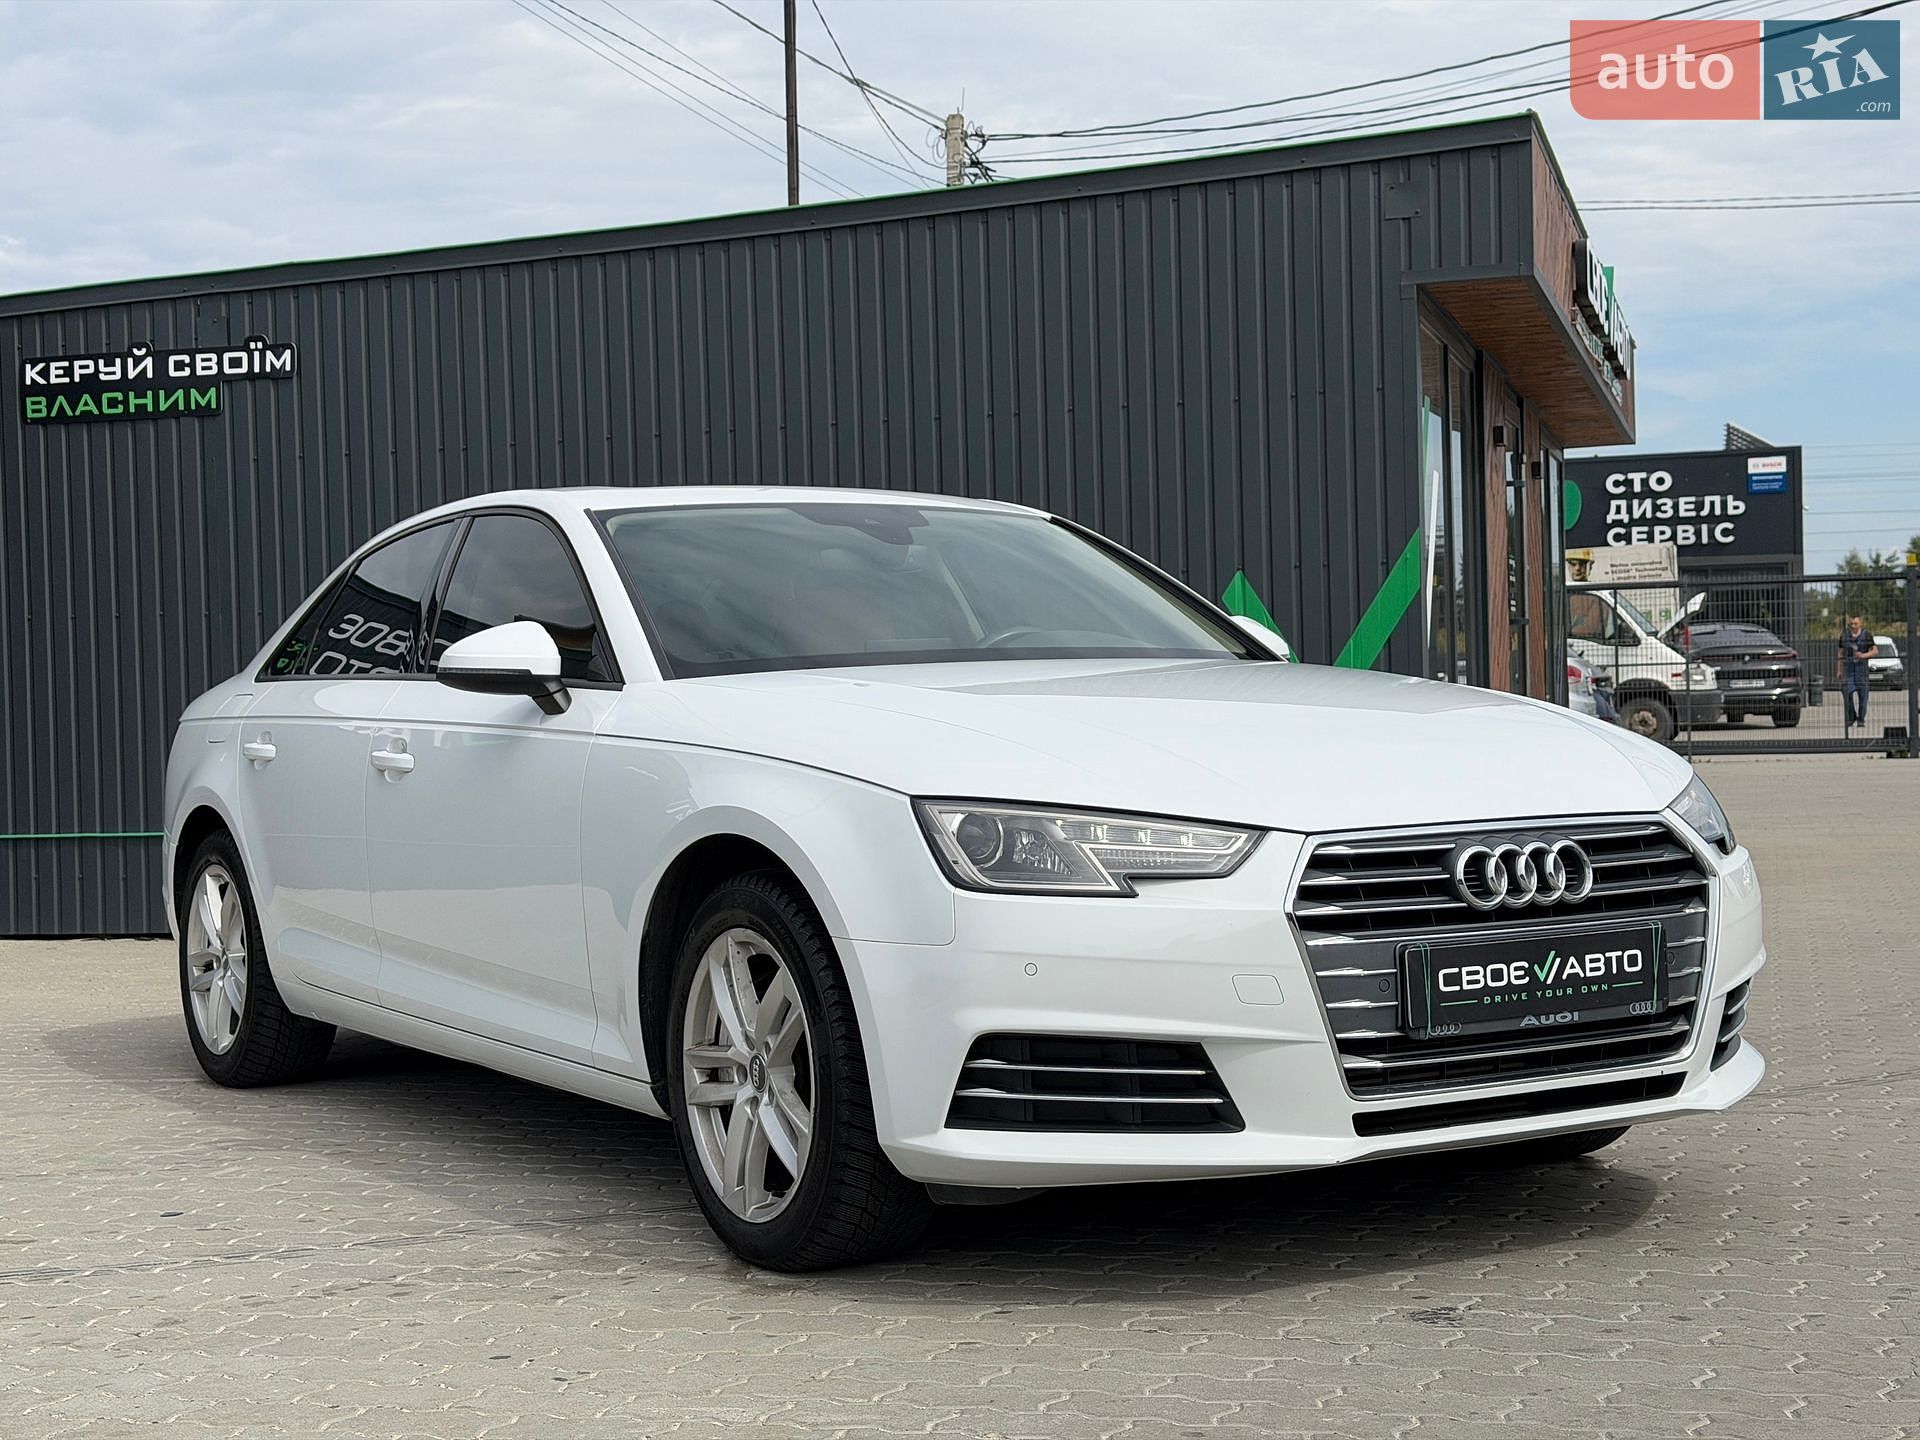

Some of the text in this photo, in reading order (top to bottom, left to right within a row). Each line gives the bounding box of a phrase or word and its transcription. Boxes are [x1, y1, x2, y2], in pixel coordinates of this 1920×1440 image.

[25, 341, 292, 385] КЕРУЙ СВОЇМ
[25, 387, 217, 418] ВЛАСНИМ
[1605, 470, 1673, 495] СТО
[1606, 494, 1746, 524] ДИЗЕЛЬ
[1606, 521, 1736, 547] СЕРВІС
[1562, 949, 1642, 981] АВТО
[1483, 983, 1609, 1004] DRIVE YOUR OWN
